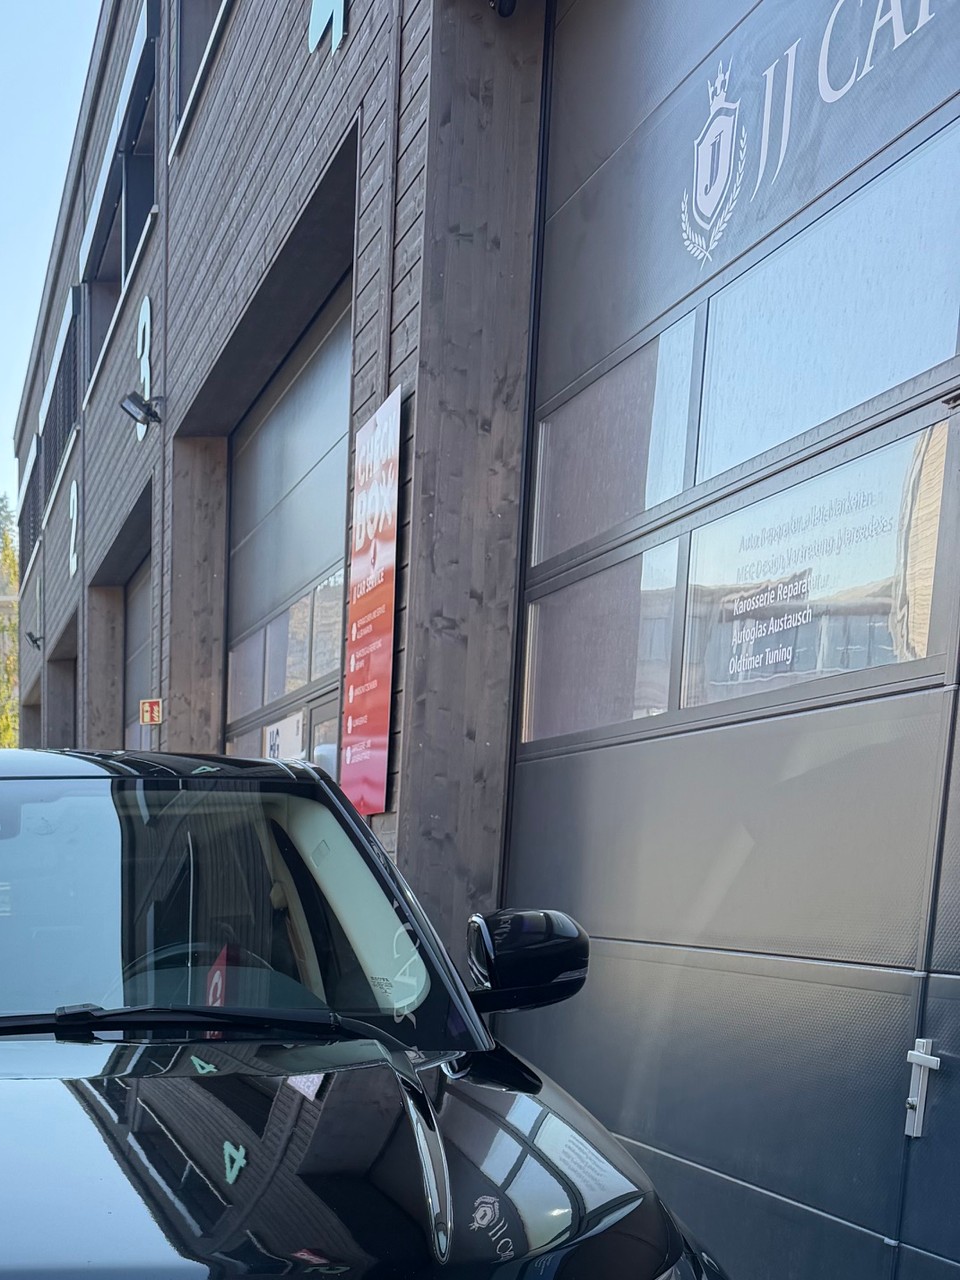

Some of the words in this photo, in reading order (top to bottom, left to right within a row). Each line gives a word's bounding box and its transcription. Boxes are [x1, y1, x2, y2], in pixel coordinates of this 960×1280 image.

[750, 38, 802, 202] JJ
[136, 295, 151, 441] 3
[69, 479, 79, 579] 2
[355, 461, 395, 551] BOX
[731, 620, 767, 646] Autoglas
[767, 604, 812, 635] Austausch
[733, 586, 775, 616] Karosserie
[728, 652, 763, 675] Oldtimer
[765, 644, 793, 665] Tuning
